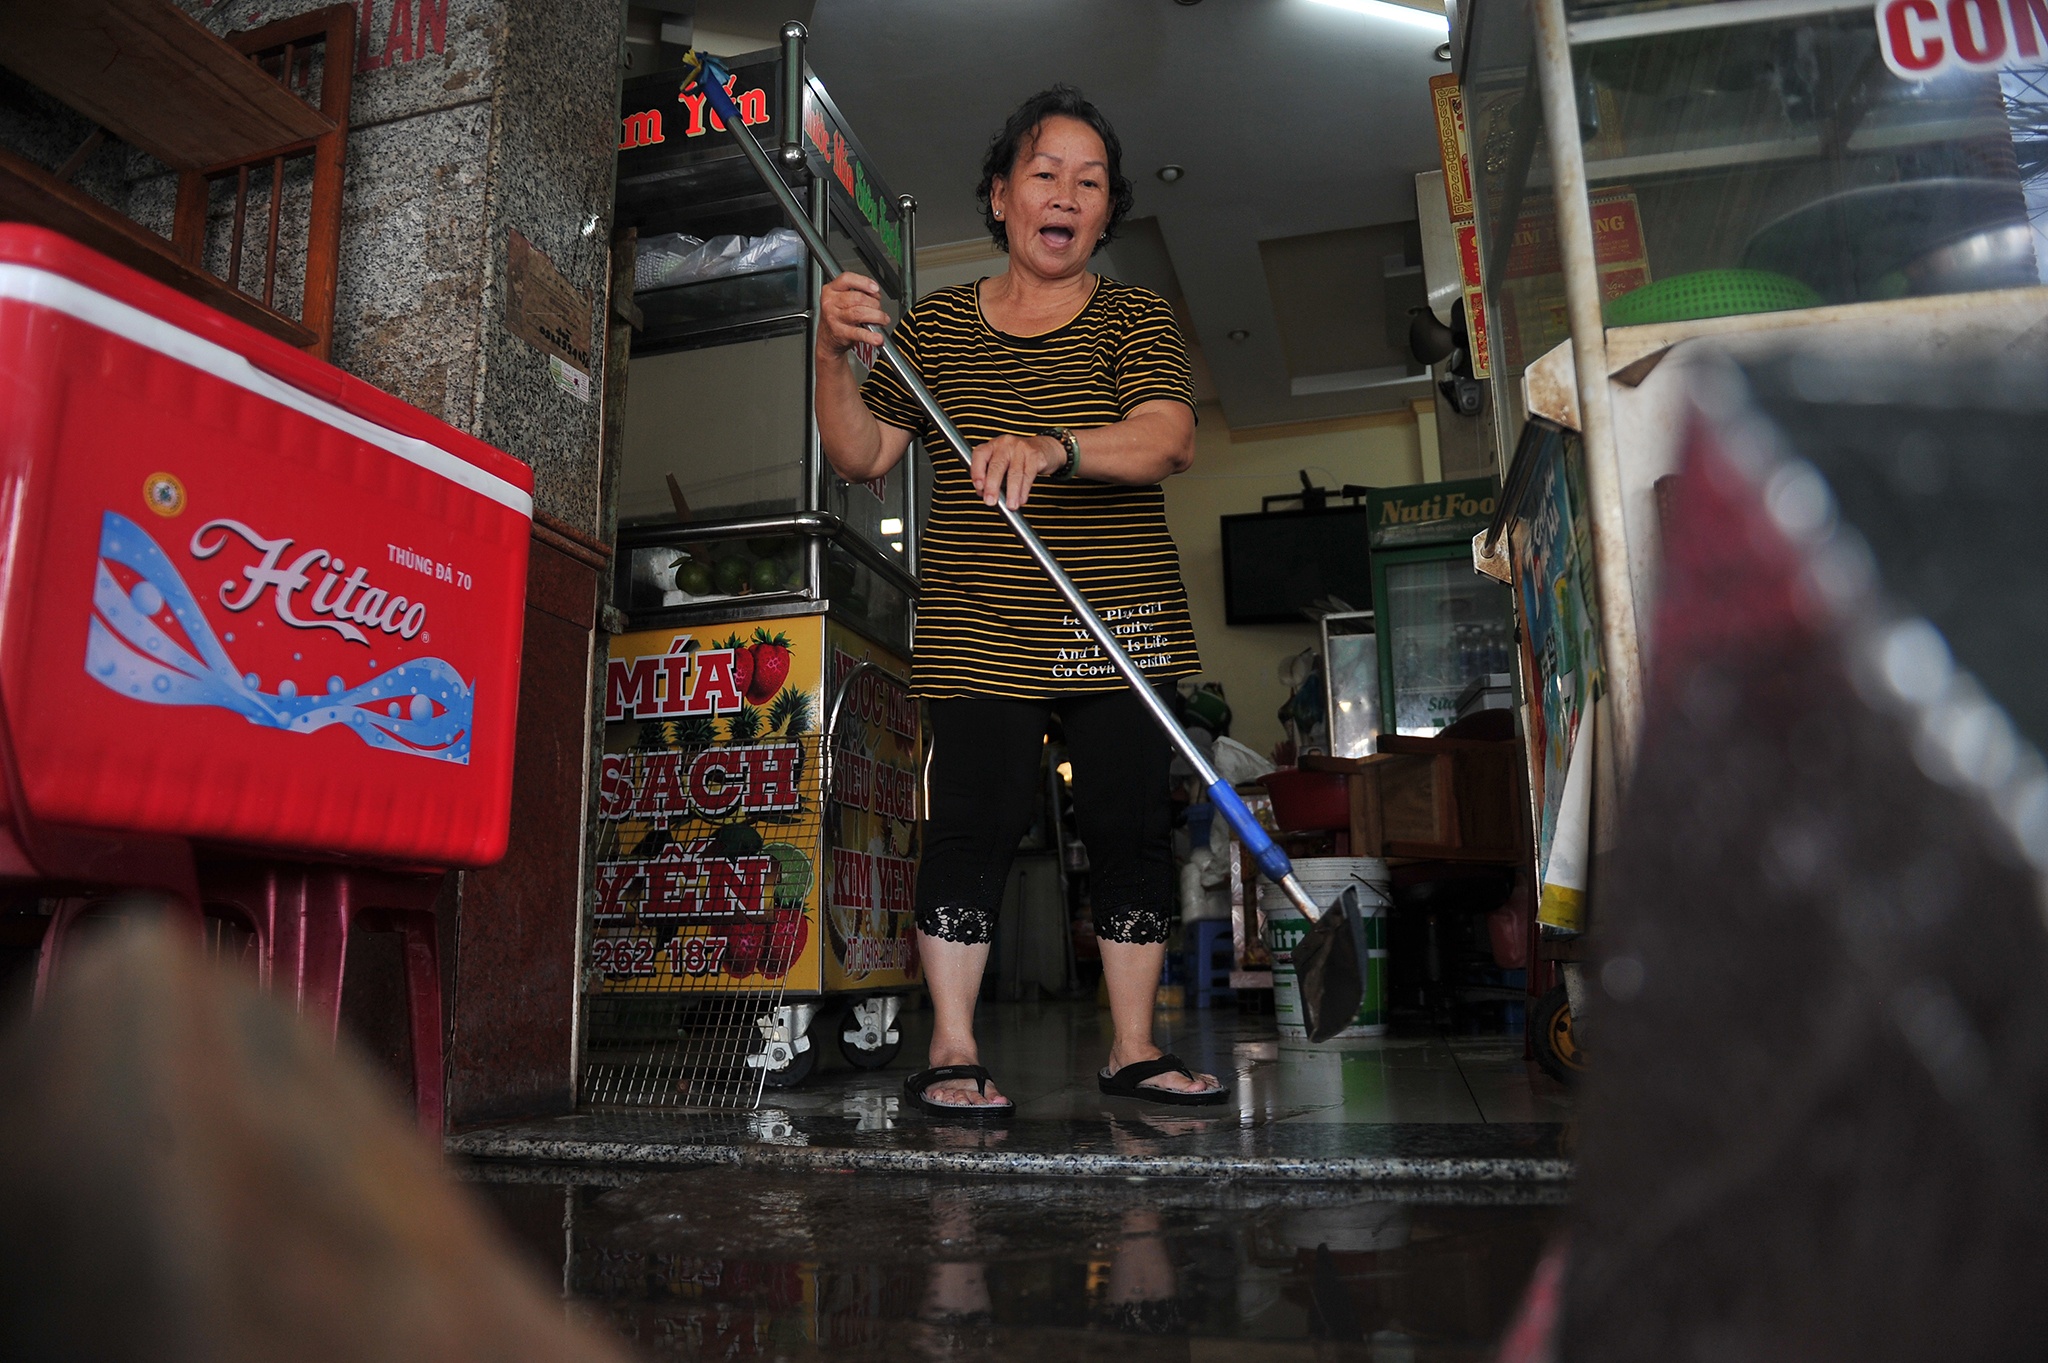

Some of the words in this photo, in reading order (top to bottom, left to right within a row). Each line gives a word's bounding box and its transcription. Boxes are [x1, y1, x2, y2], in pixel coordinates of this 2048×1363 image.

[190, 519, 427, 648] Hitaco
[387, 543, 433, 576] THÙNG
[435, 562, 453, 584] ĐÁ
[457, 571, 472, 590] 70
[605, 634, 743, 722] MÍA
[600, 742, 800, 831] SẠCH
[833, 738, 872, 812] SIÊU
[874, 760, 916, 829] SẠCH
[594, 837, 771, 920] YẾN
[832, 846, 872, 911] KIM
[876, 834, 916, 912] YẾN
[593, 939, 655, 974] 262
[664, 936, 728, 973] 187
